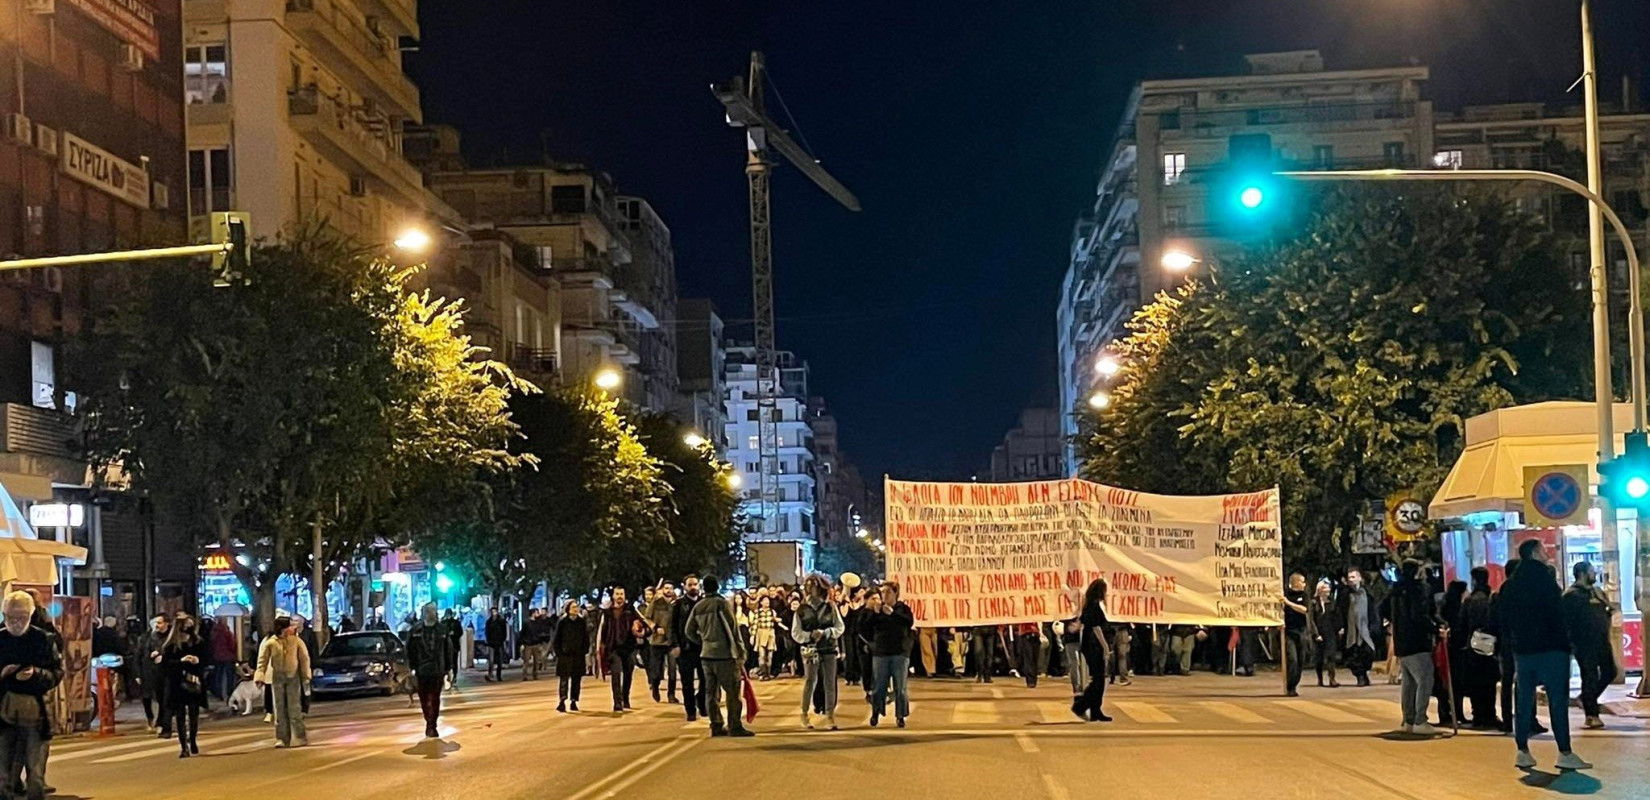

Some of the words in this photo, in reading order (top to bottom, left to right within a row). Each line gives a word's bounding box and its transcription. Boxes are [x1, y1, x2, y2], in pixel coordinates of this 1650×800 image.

[69, 141, 111, 185] ΣΥΡΙΖΑ
[949, 484, 964, 506] ΤΟΥ
[970, 484, 1020, 507] ΝΟΕΜΒΡΗ
[1027, 482, 1051, 505] ΔΕΝ
[1399, 509, 1421, 525] 30
[905, 574, 938, 595] ΑΣΥΛΟ
[940, 574, 972, 594] ΜΕΝΕΙ
[978, 572, 1028, 594] ΖΩΝΤΑΝΟ
[1033, 571, 1062, 591] ΜΕΣΑ
[1111, 572, 1150, 593] ΑΓΩΝΕΣ
[933, 598, 950, 621] ΓΙΑ
[953, 598, 973, 621] ΤΗΣ
[977, 595, 1018, 619] ΓΕΝΙΑΣ
[1023, 595, 1049, 617] ΜΑΣ
